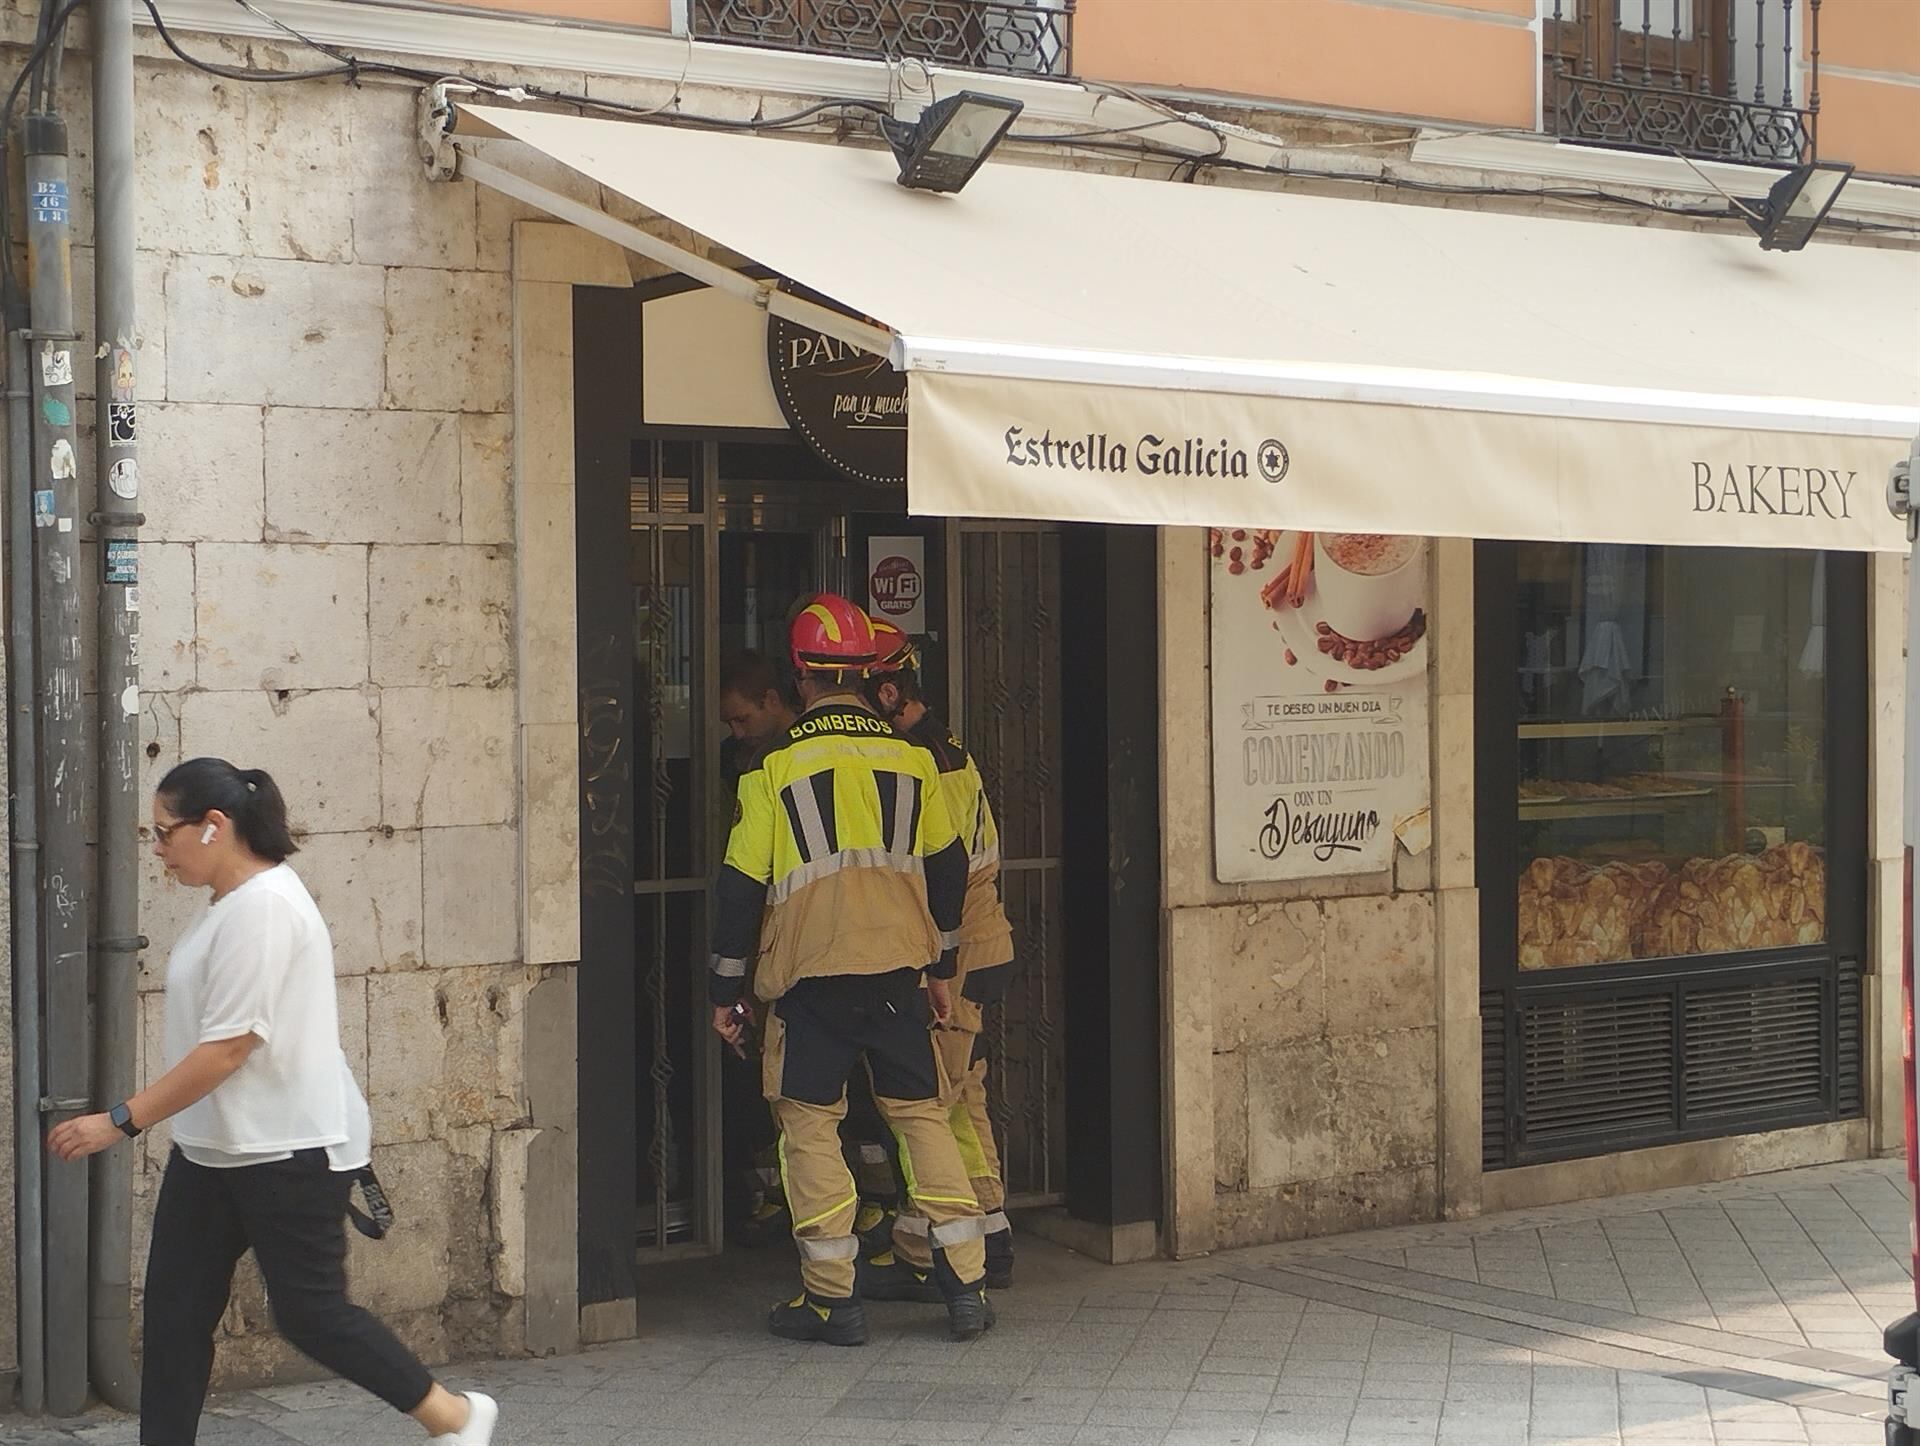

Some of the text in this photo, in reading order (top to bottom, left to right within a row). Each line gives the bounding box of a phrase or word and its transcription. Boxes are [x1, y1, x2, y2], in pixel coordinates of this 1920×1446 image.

[833, 394, 857, 418] pan
[855, 396, 882, 422] y
[1005, 425, 1127, 473] Estrella
[1136, 434, 1249, 478] Galicia
[1691, 461, 1857, 519] BAKERY
[881, 601, 911, 609] GRATIS
[1267, 704, 1280, 716] TE
[1283, 704, 1315, 714] DESEO
[1318, 704, 1332, 713] UN
[1334, 702, 1358, 713] BUEN
[790, 714, 893, 739] BOMBEROS
[1242, 731, 1404, 786] COMENZANDO
[1294, 791, 1333, 806] CON UN
